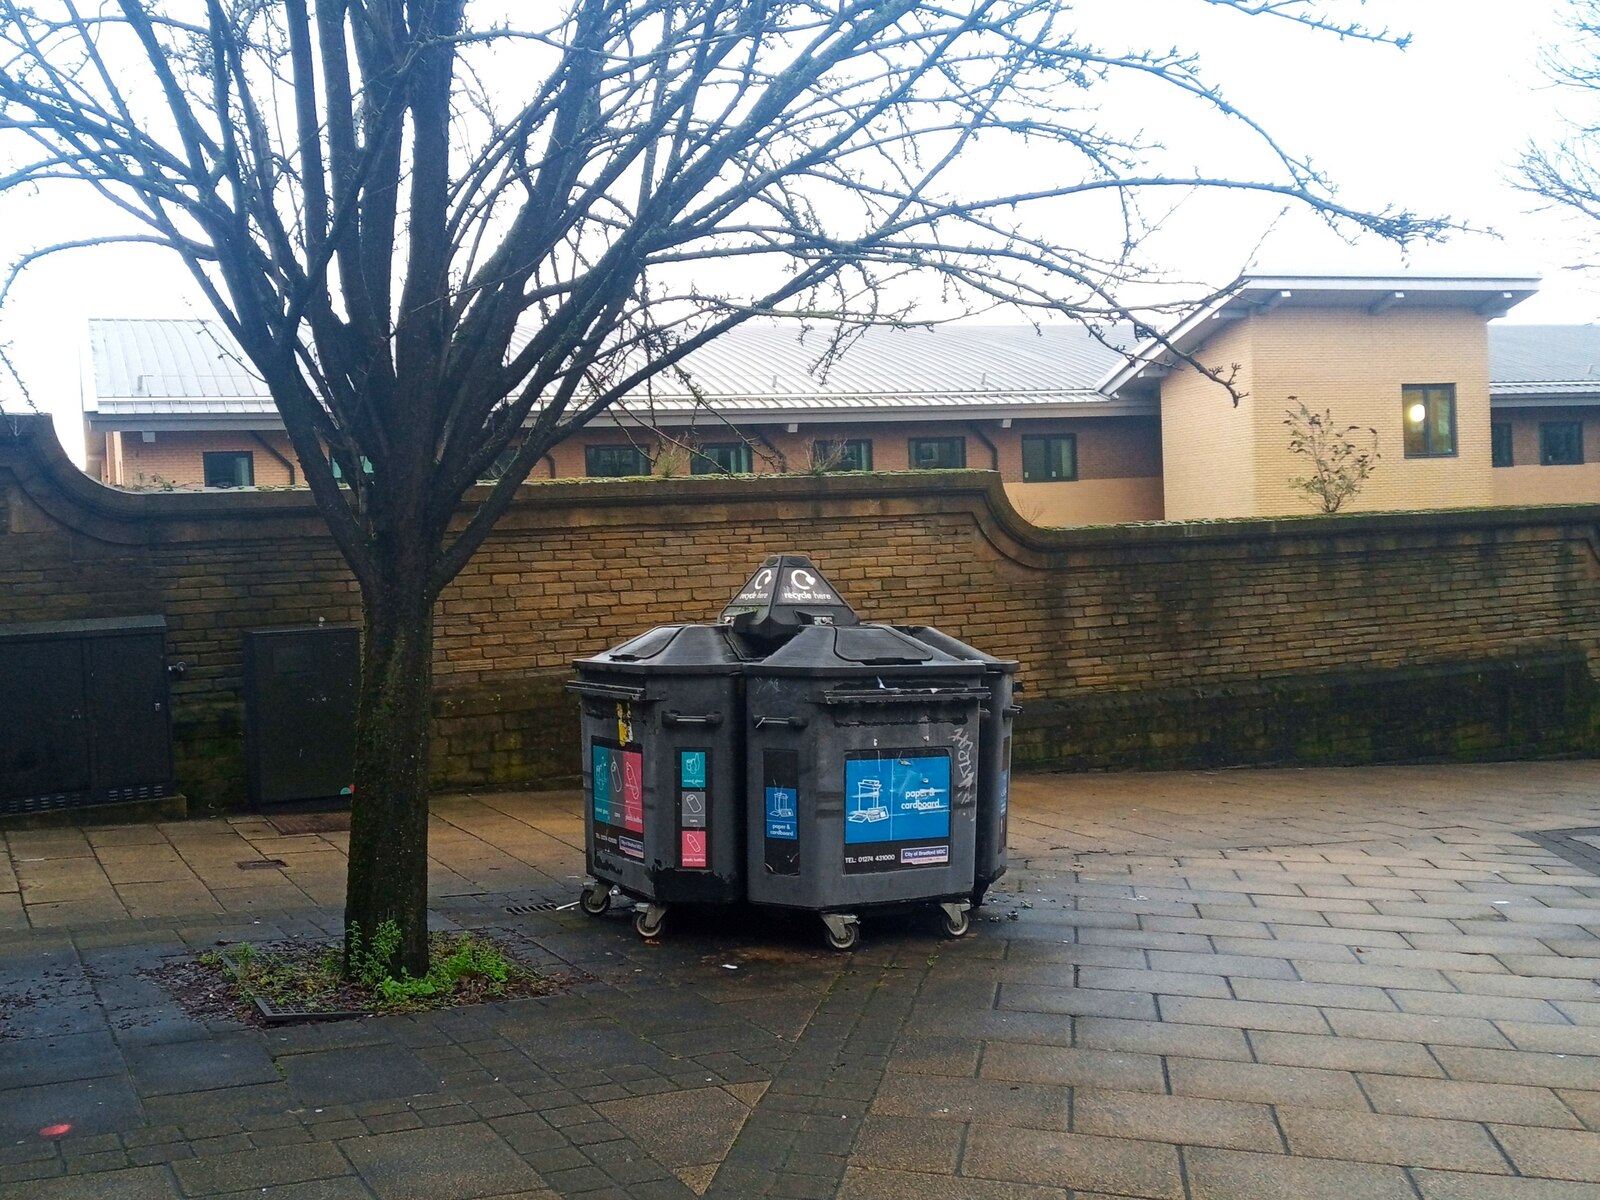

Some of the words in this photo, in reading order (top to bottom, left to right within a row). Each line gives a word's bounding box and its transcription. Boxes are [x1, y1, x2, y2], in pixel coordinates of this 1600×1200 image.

[784, 591, 812, 600] recycle
[813, 590, 832, 600] here
[905, 791, 927, 800] paper
[900, 798, 940, 810] cardboard
[858, 855, 874, 863] 01274
